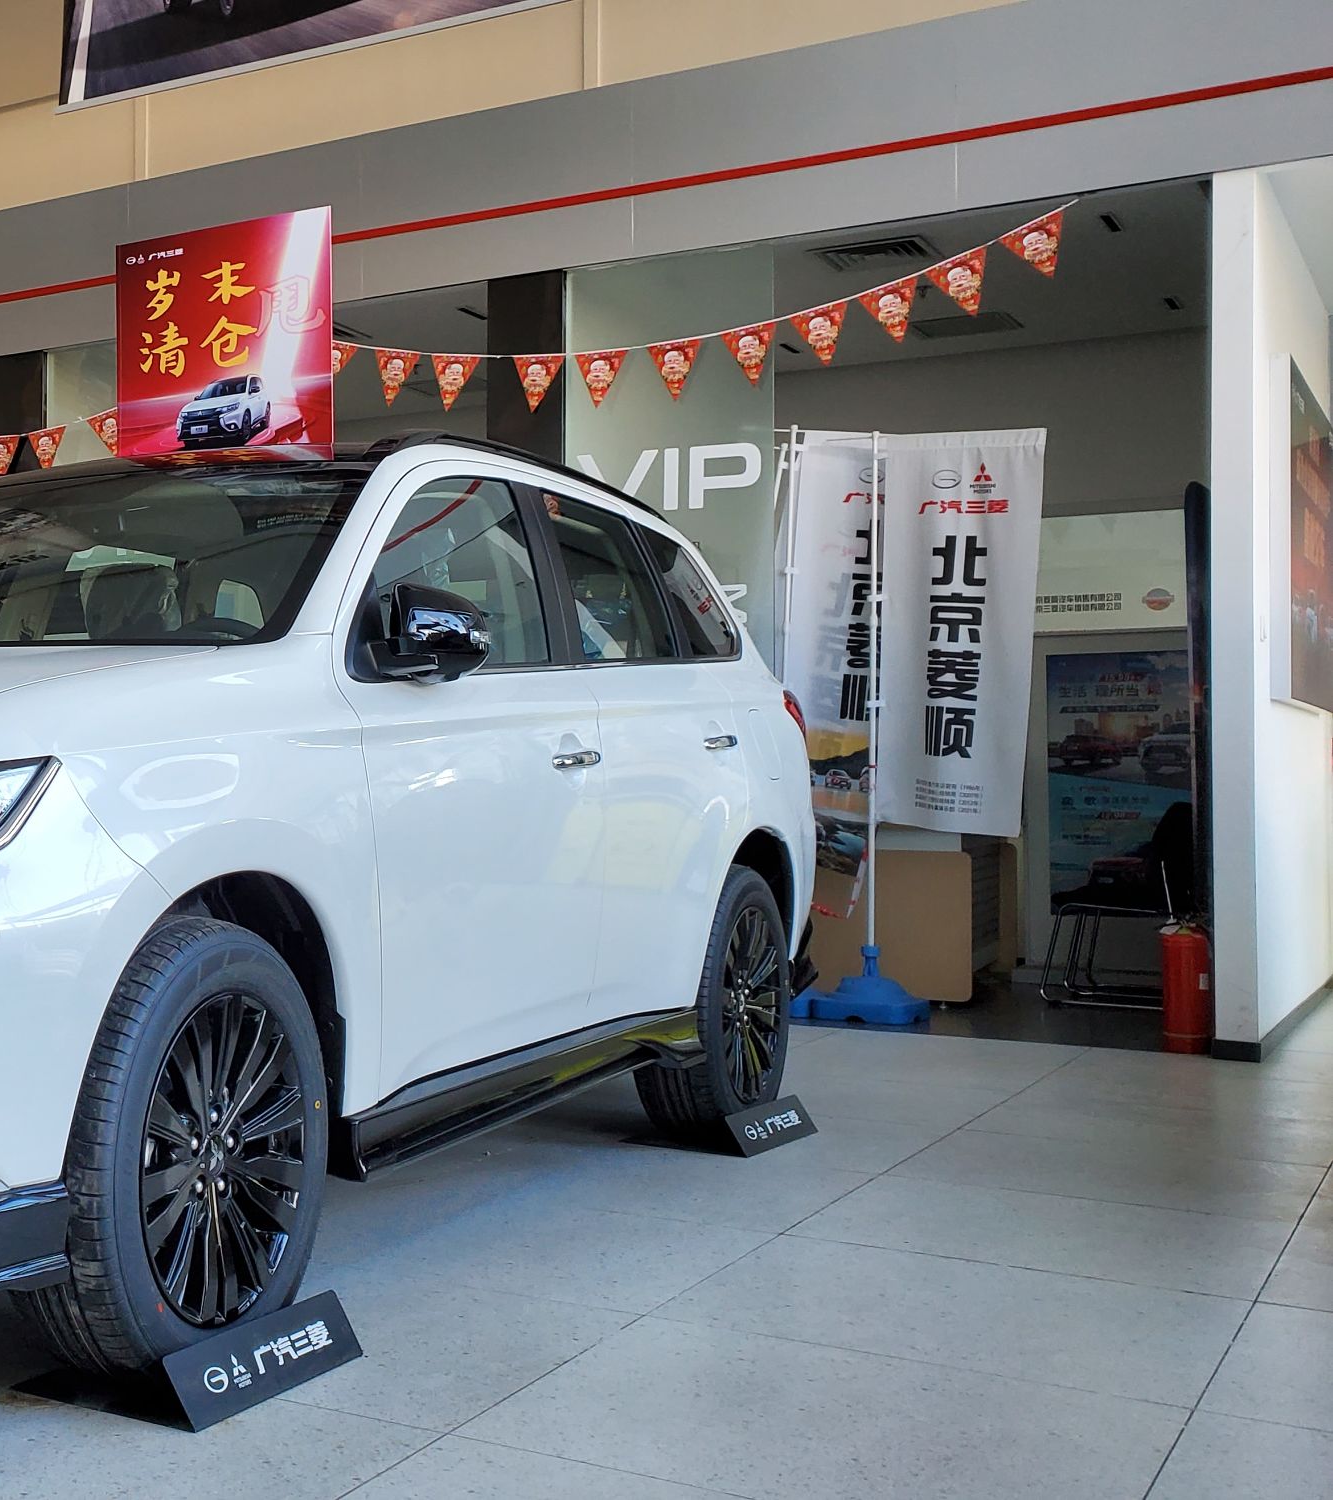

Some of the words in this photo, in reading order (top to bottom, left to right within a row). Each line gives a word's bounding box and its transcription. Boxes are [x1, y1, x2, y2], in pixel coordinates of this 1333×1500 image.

[145, 261, 256, 321] 岁末
[139, 315, 258, 378] 清仓
[577, 442, 762, 511] VIP
[918, 499, 1009, 515] 广汽三菱
[924, 534, 988, 759] 北京菱顺
[253, 1320, 333, 1375] 广汽三菱
